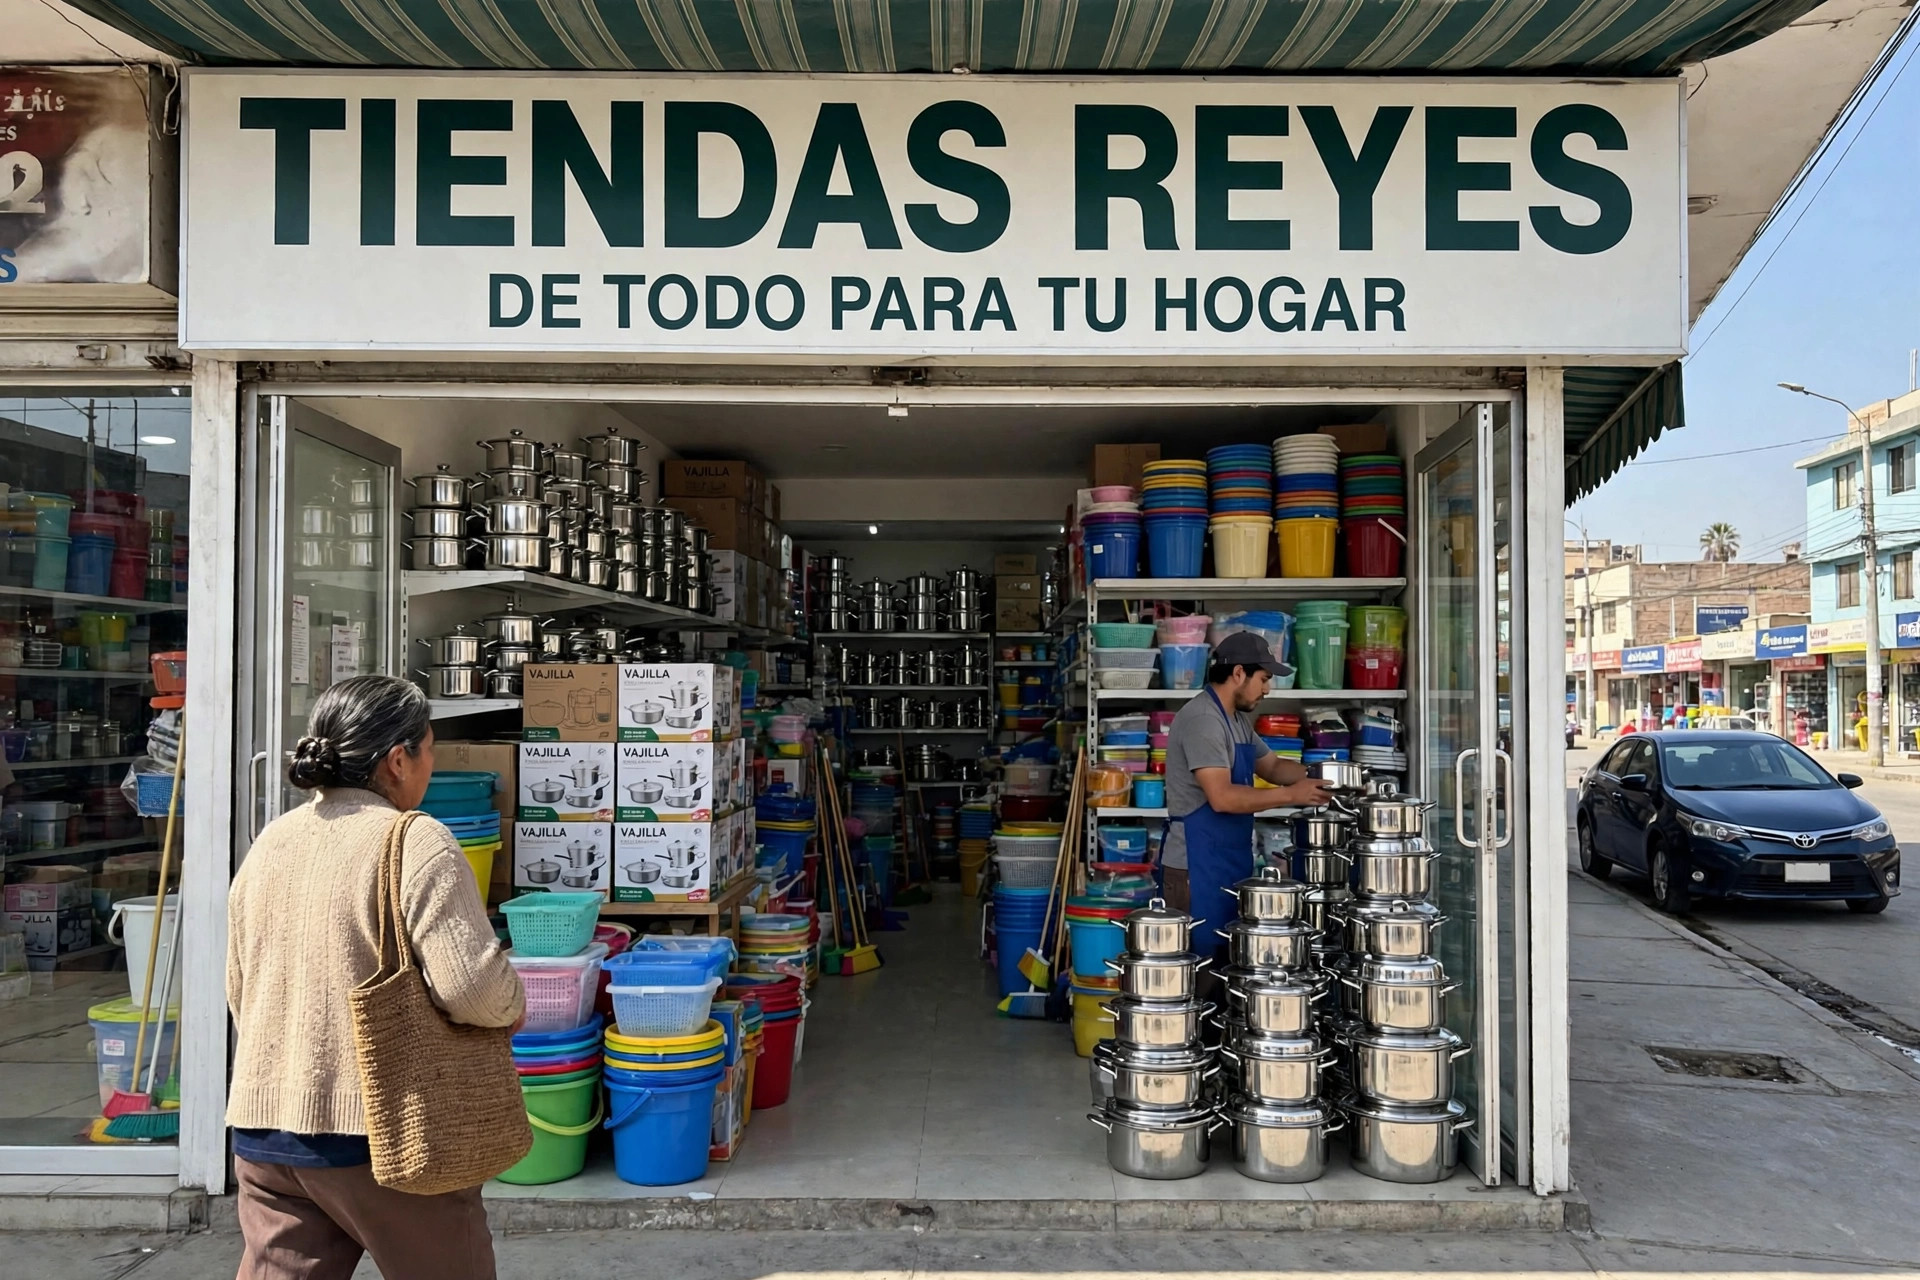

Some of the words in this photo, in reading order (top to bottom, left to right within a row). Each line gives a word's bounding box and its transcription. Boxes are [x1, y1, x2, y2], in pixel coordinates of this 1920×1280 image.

[240, 97, 1010, 252] TIENDAS
[1075, 104, 1632, 254] REYES
[490, 274, 580, 328] DE
[603, 274, 805, 330] TODO
[832, 277, 1017, 331] PARA
[1039, 278, 1126, 332] TU
[1156, 276, 1406, 332] HOGAR
[683, 466, 730, 477] VAJILLA
[529, 669, 575, 680] VAJILLA
[624, 669, 670, 679] VAJILLA
[525, 748, 571, 758] VAJILLA
[623, 748, 669, 758] VAJILLA
[520, 827, 567, 838] VAJILLA
[620, 827, 667, 838] VAJILLA
